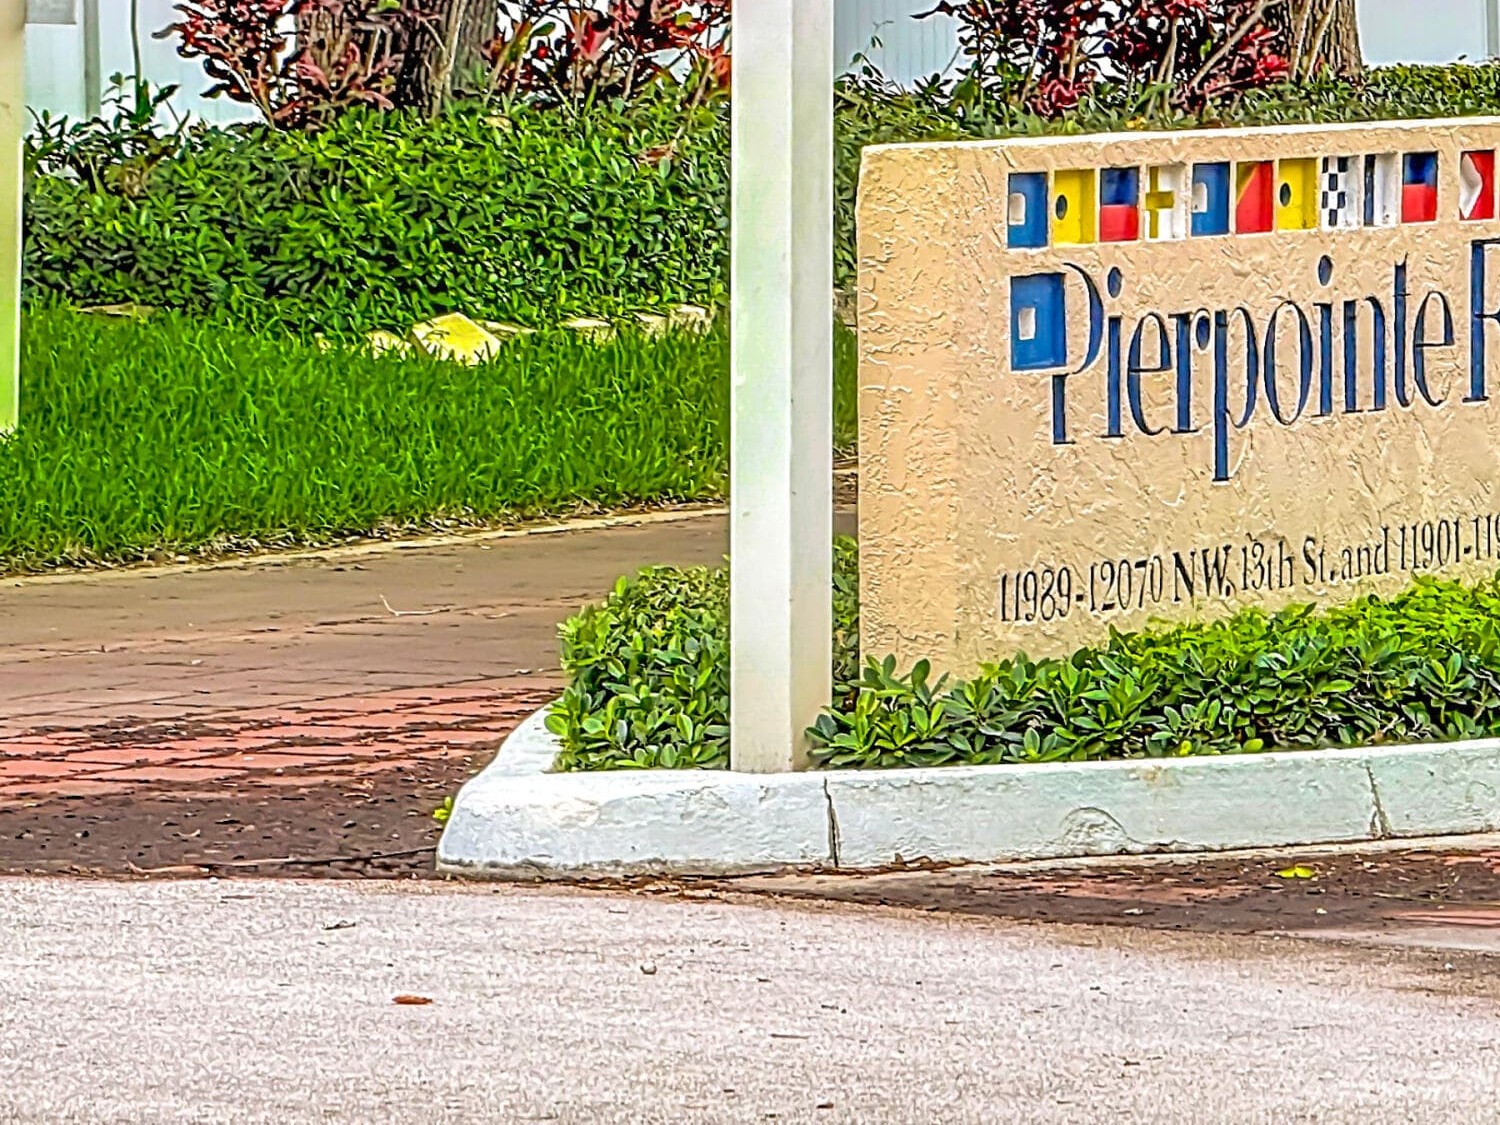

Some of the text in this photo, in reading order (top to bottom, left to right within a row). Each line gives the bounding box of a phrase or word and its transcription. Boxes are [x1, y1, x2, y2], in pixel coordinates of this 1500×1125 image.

[1010, 253, 1454, 483] Pierpointe
[1000, 555, 1164, 623] 11989-12070
[1241, 539, 1295, 591] 13th
